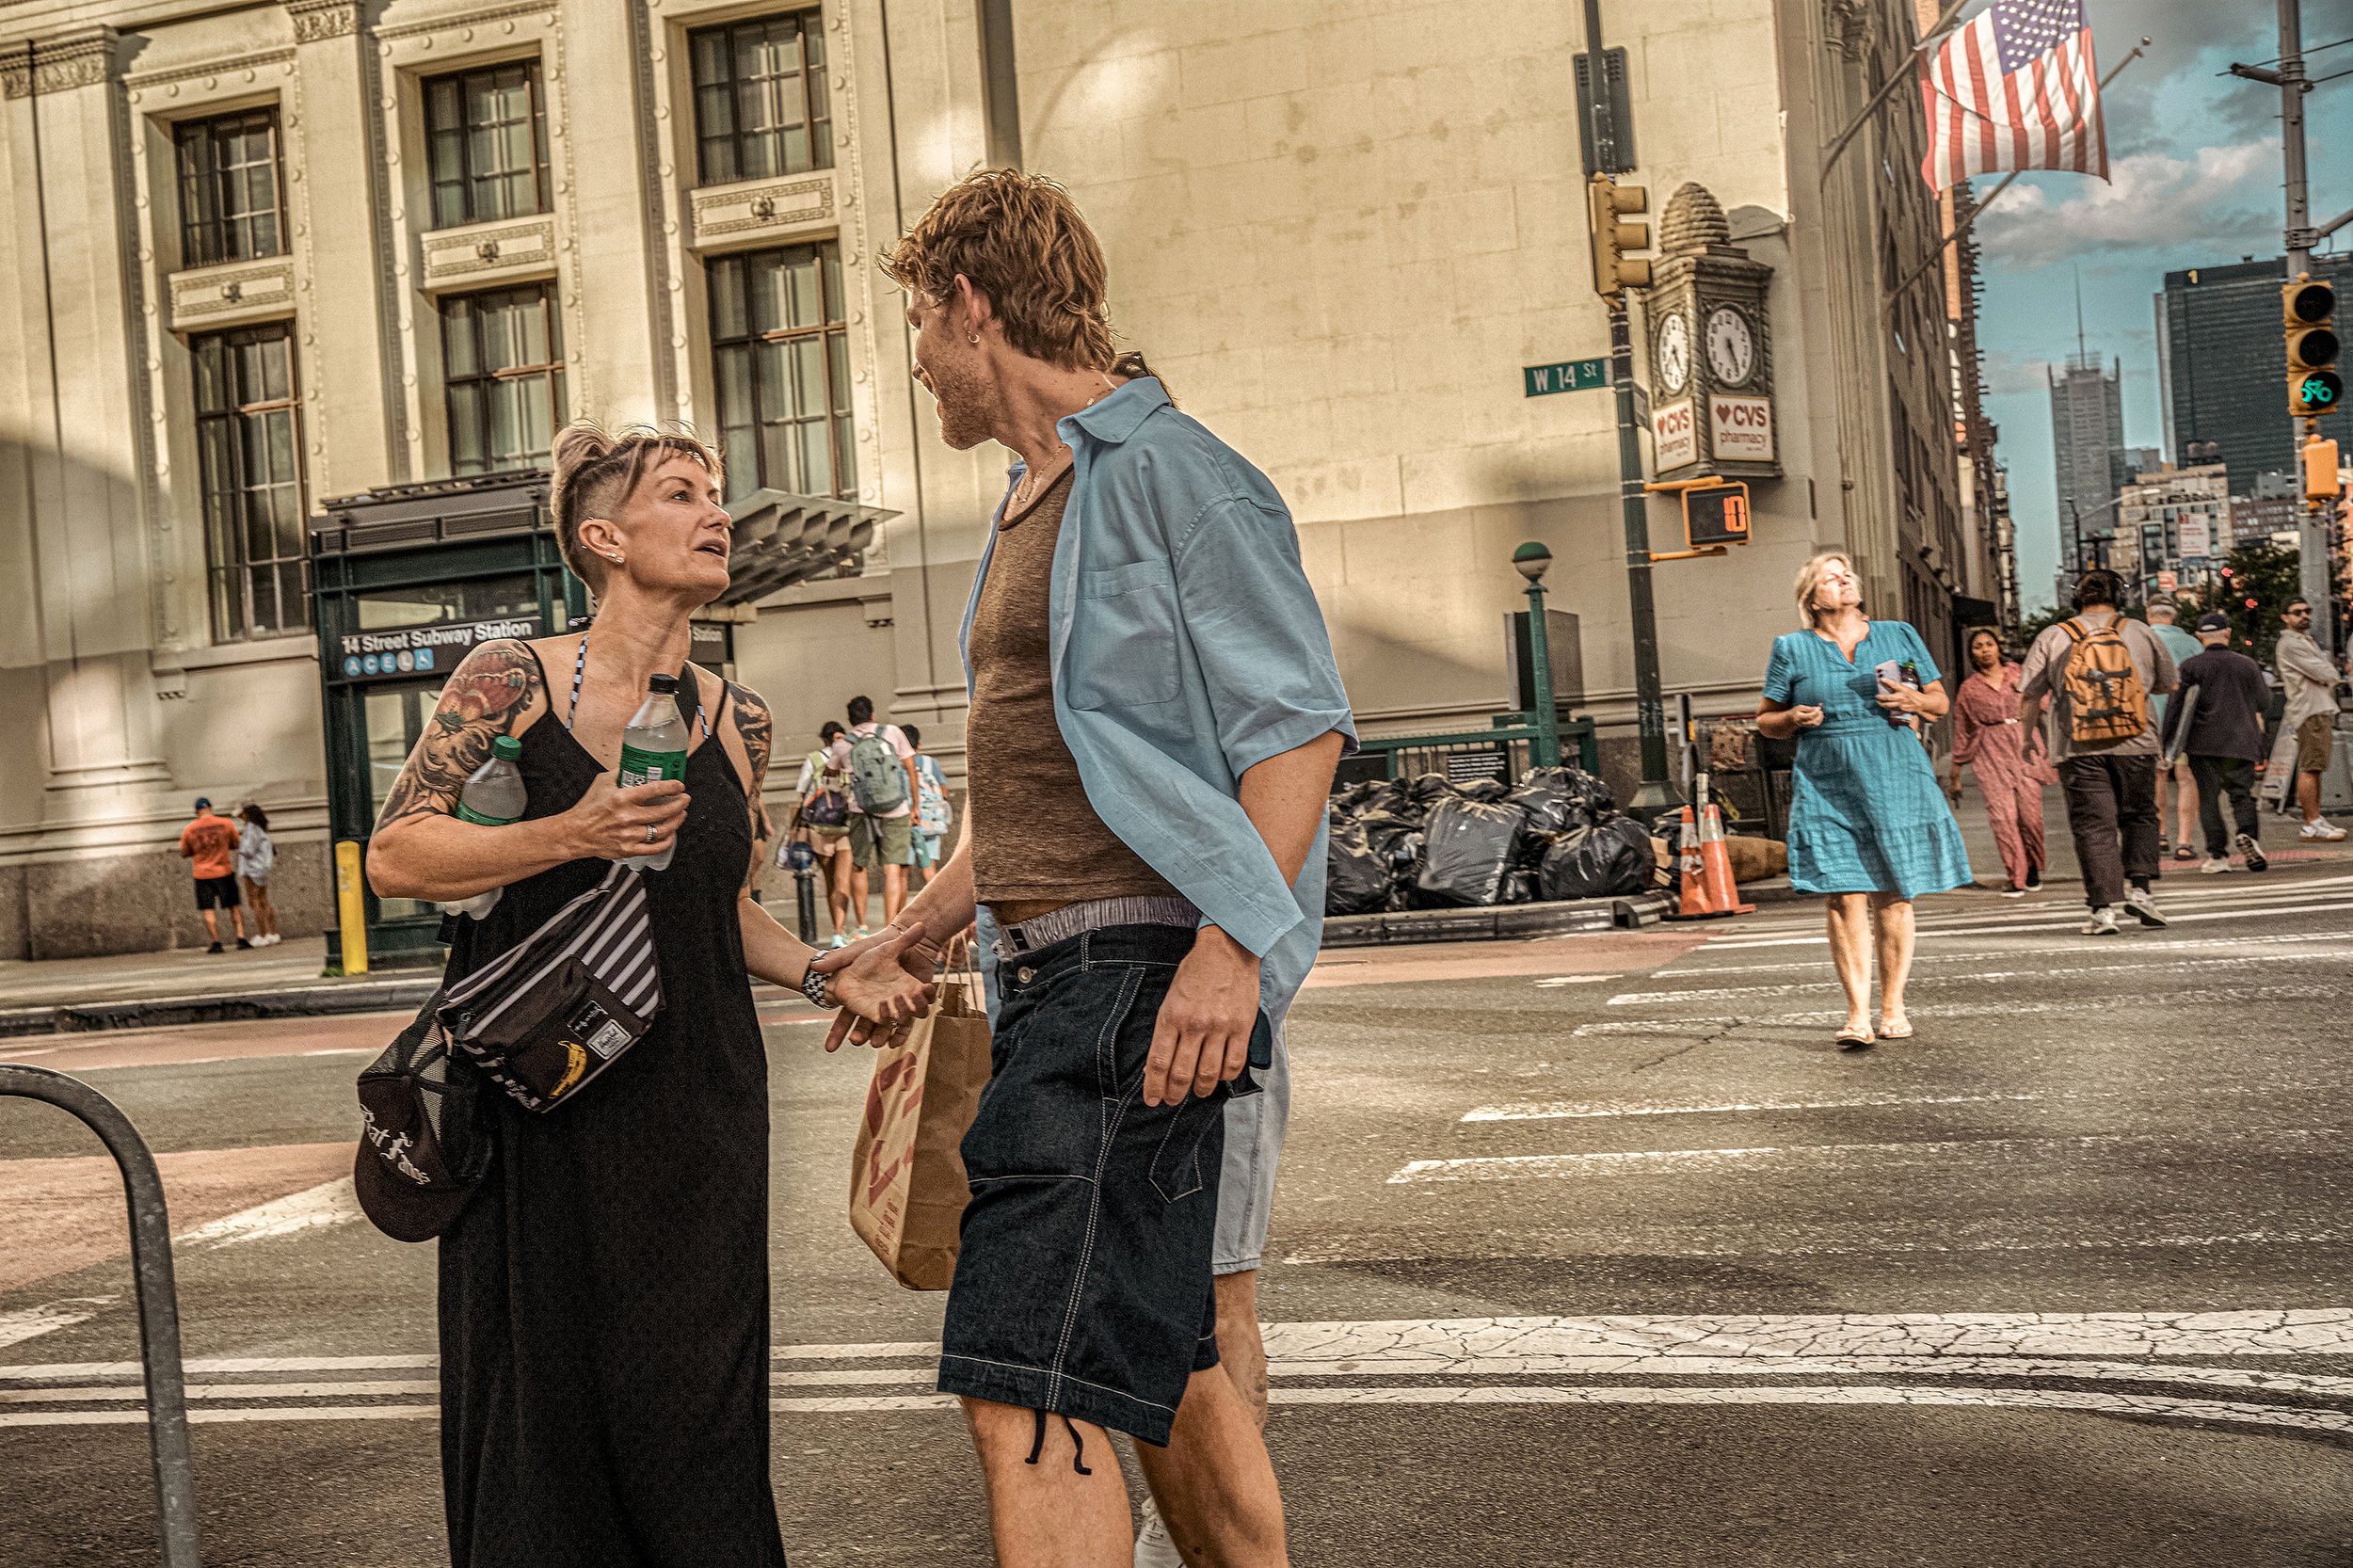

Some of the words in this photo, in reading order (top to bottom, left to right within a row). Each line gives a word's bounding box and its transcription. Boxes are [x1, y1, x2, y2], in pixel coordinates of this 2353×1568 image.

[2188, 270, 2198, 283] 1
[1533, 368, 1548, 392] W
[1557, 365, 1577, 389] 14
[1583, 362, 1597, 377] St
[1667, 408, 1689, 434] CVS
[1734, 405, 1766, 426] CVS
[1721, 429, 1766, 447] pharmacy
[342, 637, 360, 654] 14
[361, 634, 409, 652] Street
[410, 629, 472, 648] Subway
[474, 621, 533, 641] Station
